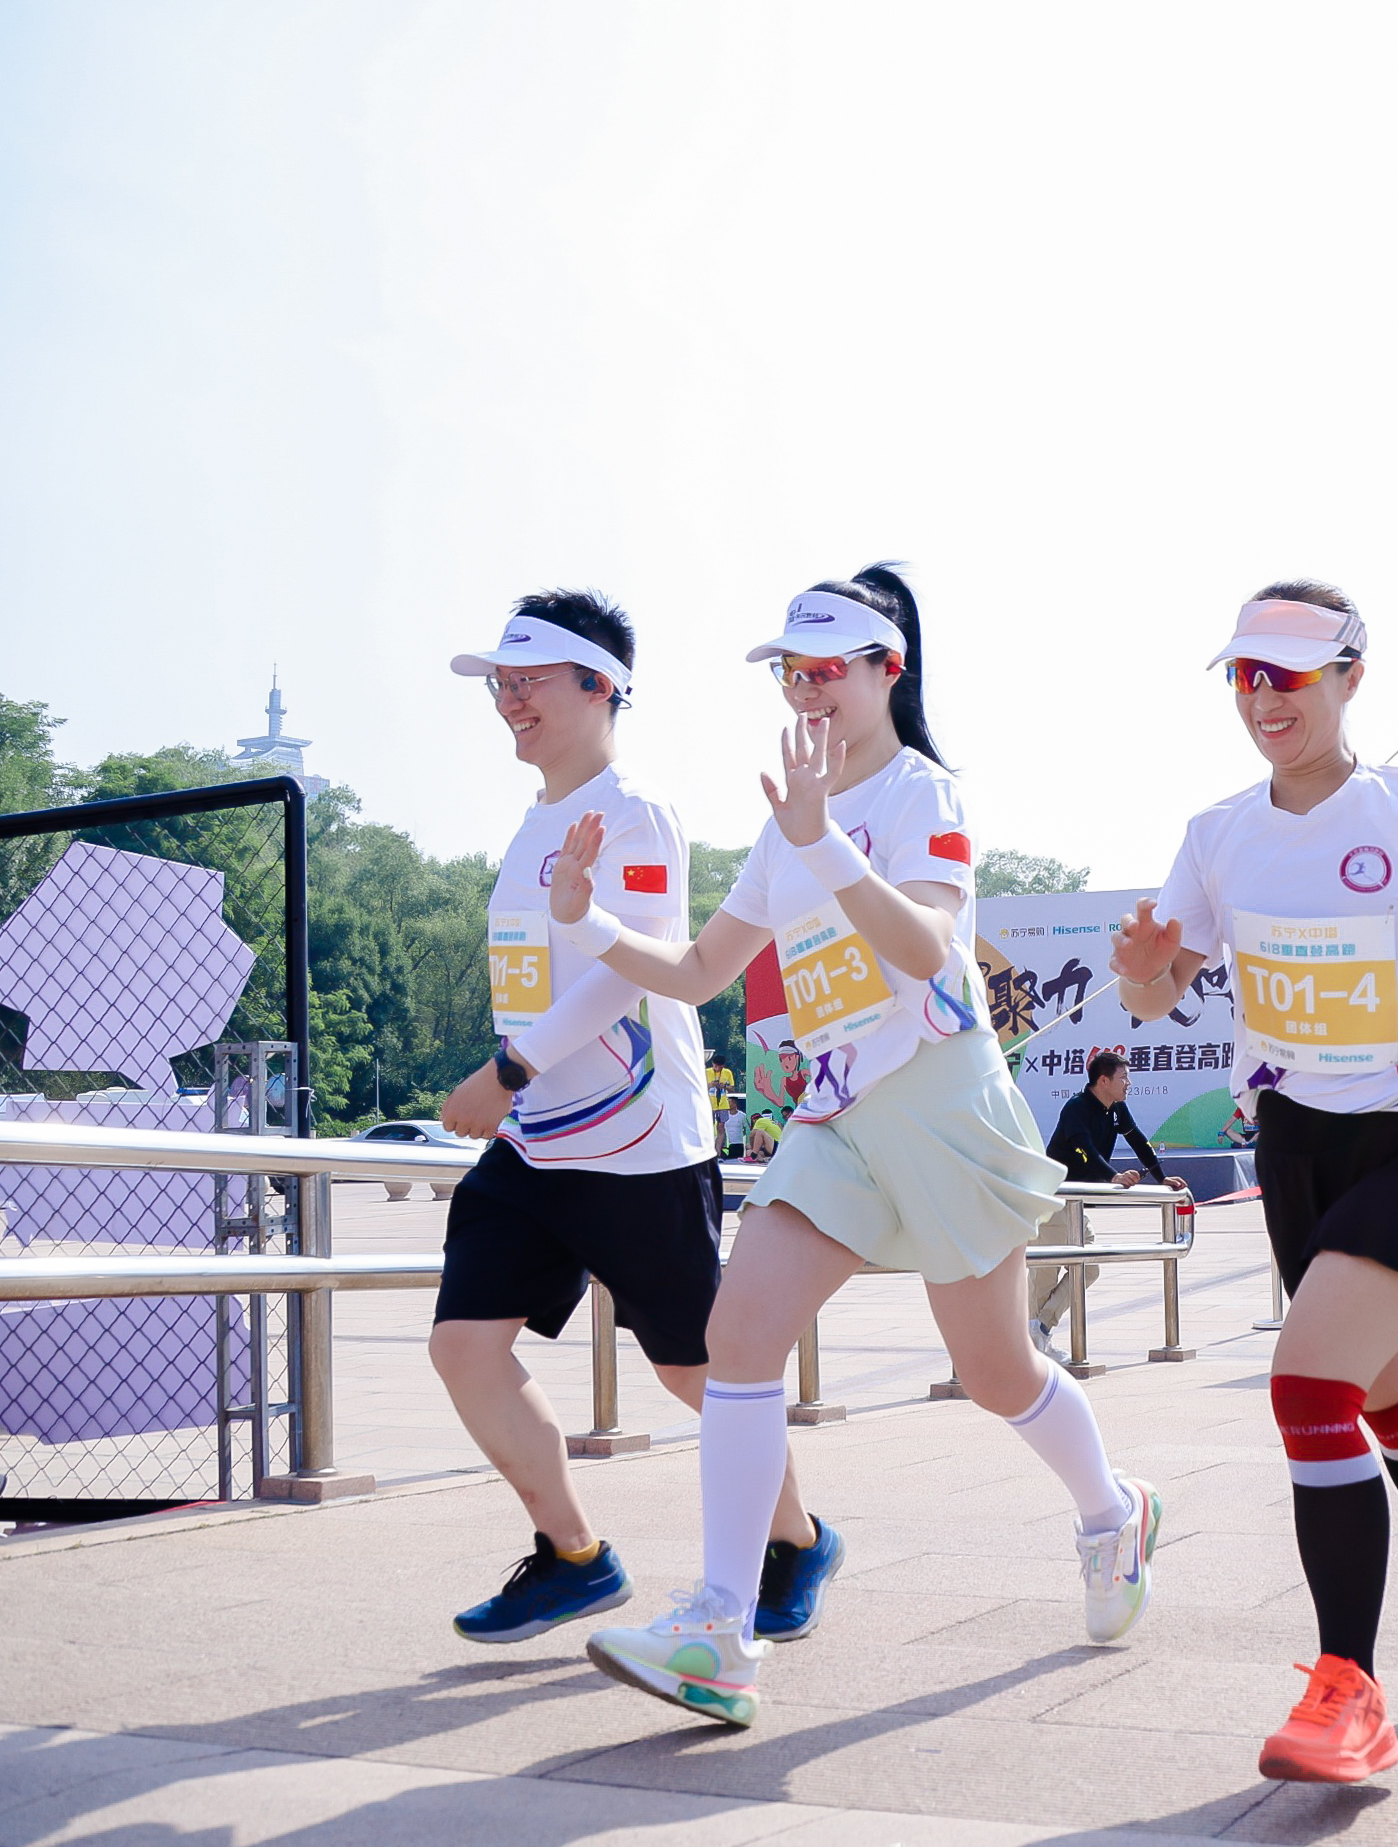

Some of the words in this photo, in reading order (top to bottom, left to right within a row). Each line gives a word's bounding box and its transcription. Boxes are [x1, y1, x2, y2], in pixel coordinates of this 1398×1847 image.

[1010, 927, 1045, 939] 苏宁易购
[1052, 925, 1101, 936] Hisense
[1260, 942, 1356, 957] 618垂直登高跑
[784, 946, 869, 1009] T01-3
[1246, 964, 1381, 1014] T01-4
[843, 1013, 882, 1033] Hisense
[1285, 1020, 1328, 1036] 团体组
[1318, 1052, 1374, 1063] Hisense
